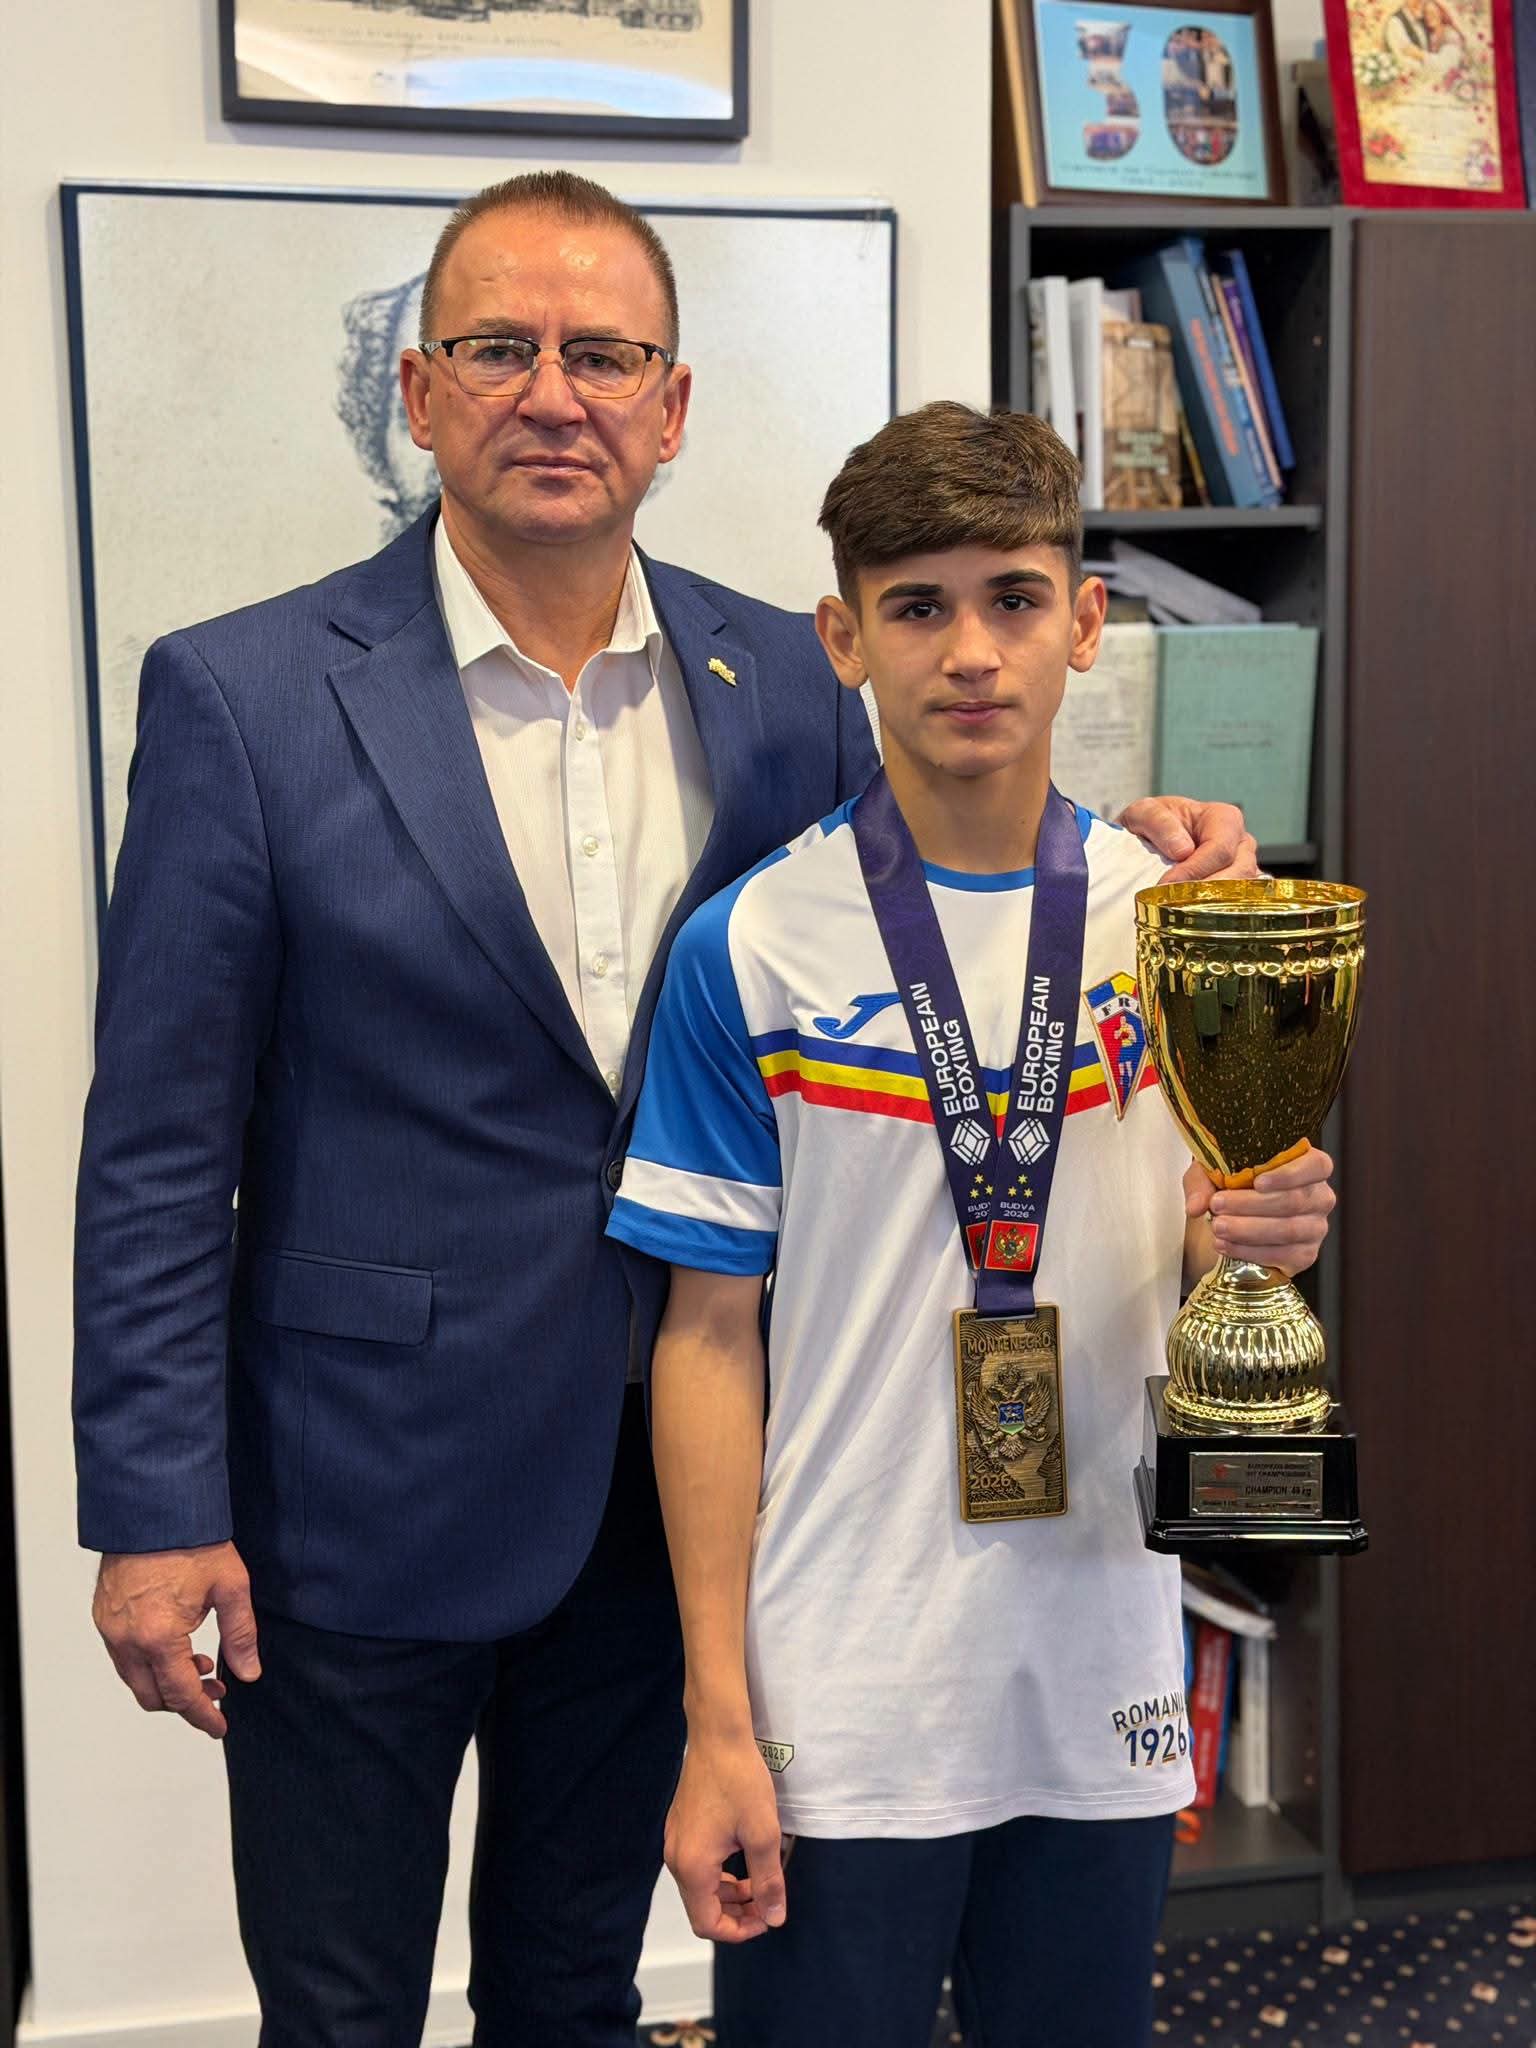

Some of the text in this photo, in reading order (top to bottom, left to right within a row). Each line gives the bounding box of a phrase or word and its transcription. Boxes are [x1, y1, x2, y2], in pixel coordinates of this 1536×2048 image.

[910, 982, 962, 1116] EUROPEAN
[943, 1019, 980, 1111] BOXING
[1017, 976, 1051, 1111] EUROPEAN
[1036, 1021, 1065, 1113] BOXING
[1000, 1201, 1035, 1211] BUDVA
[1003, 1209, 1030, 1218] 2026
[967, 1331, 1051, 1356] MONTENEGRO
[970, 1473, 1011, 1490] 2026
[1124, 1717, 1187, 1767] 1926
